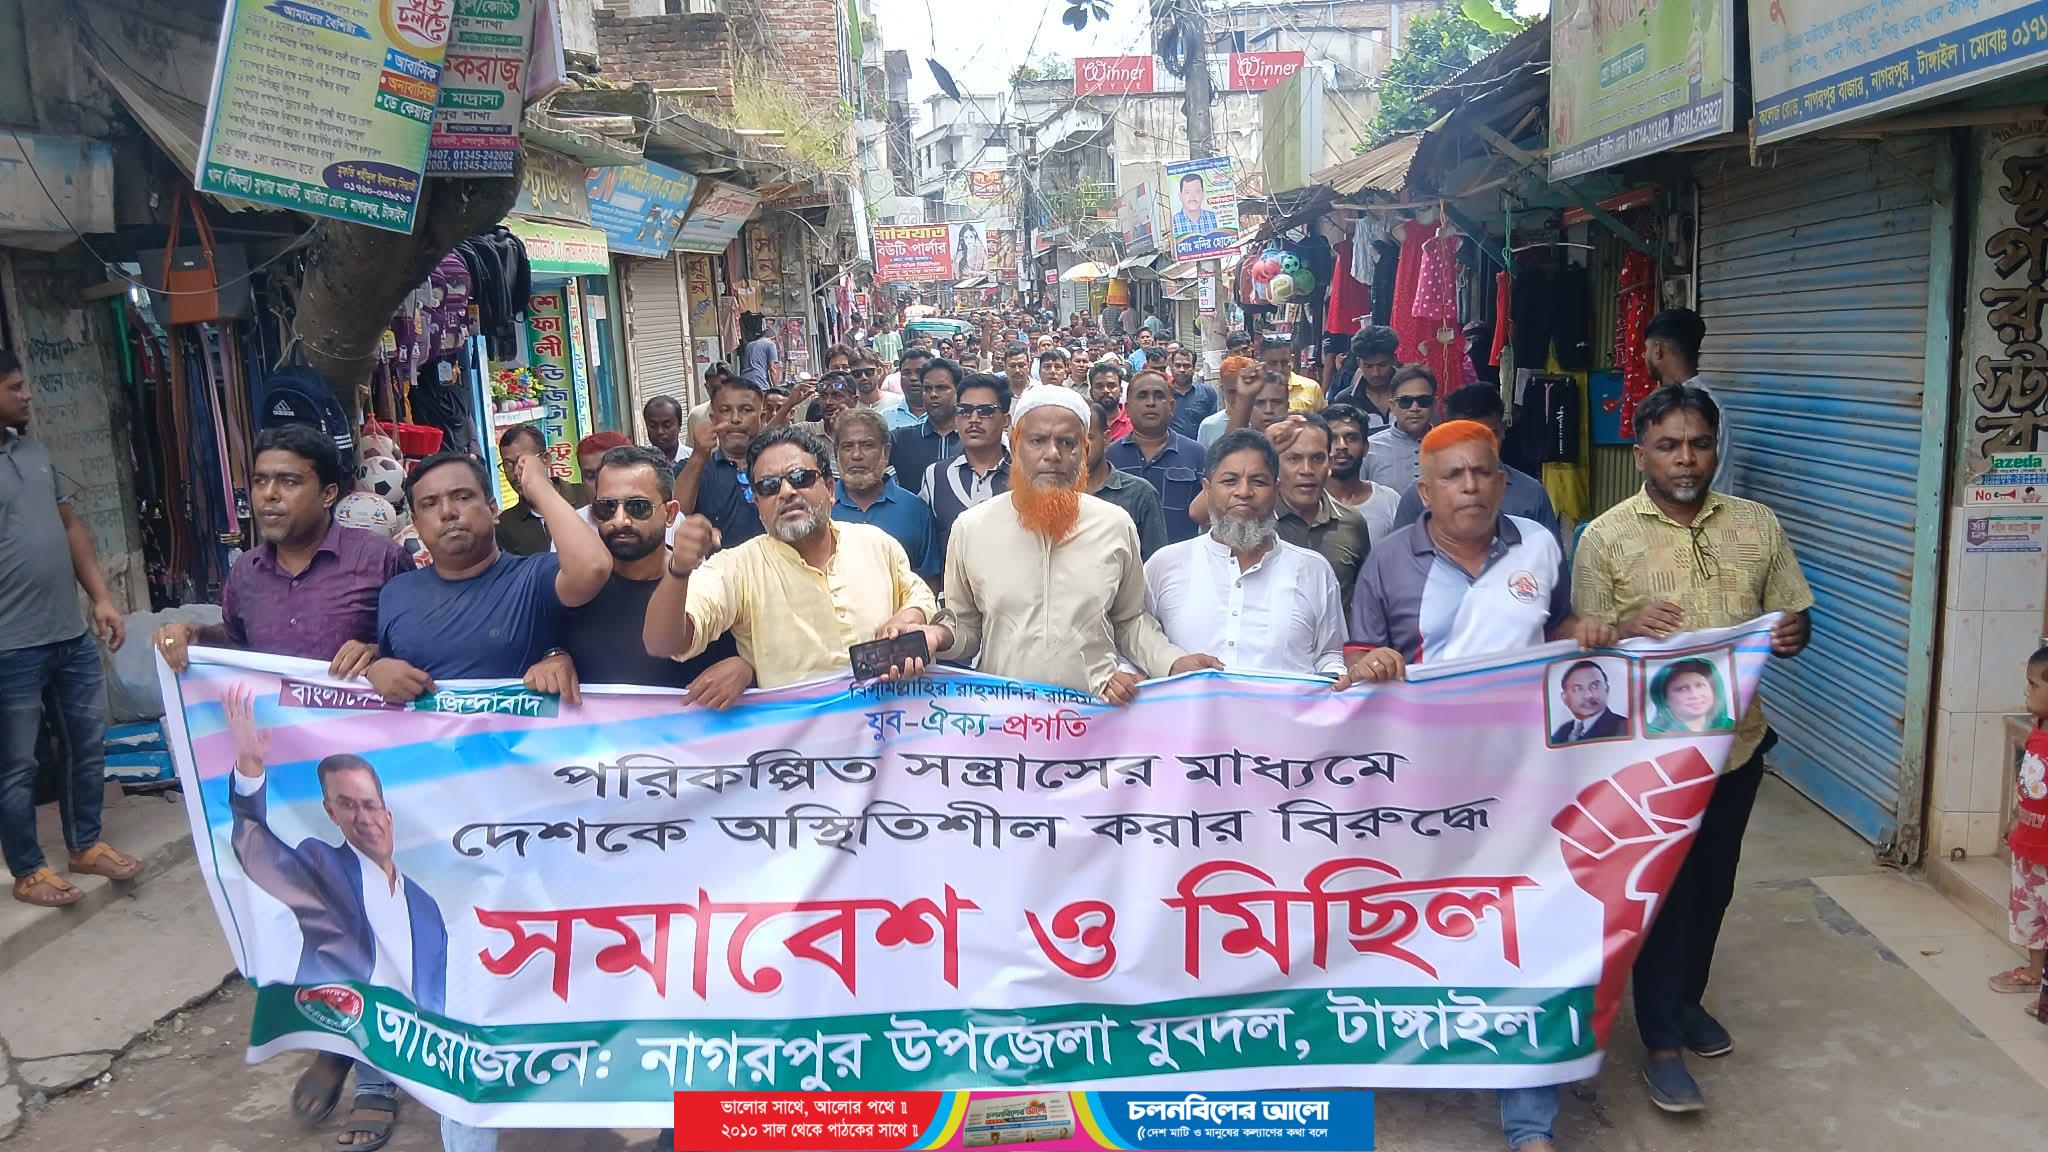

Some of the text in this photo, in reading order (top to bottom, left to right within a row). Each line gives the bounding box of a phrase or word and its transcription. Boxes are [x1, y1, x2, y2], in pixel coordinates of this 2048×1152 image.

[398, 6, 449, 42] চলছে
[475, 19, 504, 30] শাখা
[394, 54, 439, 82] আবাসিক
[1083, 59, 1145, 82] Winner
[1237, 57, 1298, 78] Winner
[1084, 82, 1142, 92] STYLE
[1804, 84, 1836, 113] নাগরপুর
[1838, 76, 1869, 104] বাজার,
[1870, 59, 1915, 91] নাগরপুর,
[384, 94, 400, 110] ডে
[400, 101, 433, 123] কেয়ার
[451, 92, 500, 108] মাদ্রাসা
[463, 110, 491, 121] শাখা
[454, 149, 514, 161] 01345-242002
[911, 239, 947, 257] পার্লার
[529, 294, 563, 358] শেফালী
[1991, 454, 2043, 469] azeda
[1975, 490, 1992, 501] No
[435, 690, 544, 716] জিন্দাবাদ
[553, 748, 1411, 801] পরিকল্পিত সন্ত্রাসের মাধ্যমে
[451, 797, 1501, 859] দেশকে অস্থিতিশীল করার বিরুদ্ধে
[473, 857, 1541, 1005] সমাবেশ ও মিছিল
[636, 1029, 872, 1092] নাগরপুর
[882, 1013, 1121, 1074] উপজেলা
[1131, 1006, 1311, 1071] যুবদল,
[1325, 989, 1546, 1056] টাঙ্গাইল
